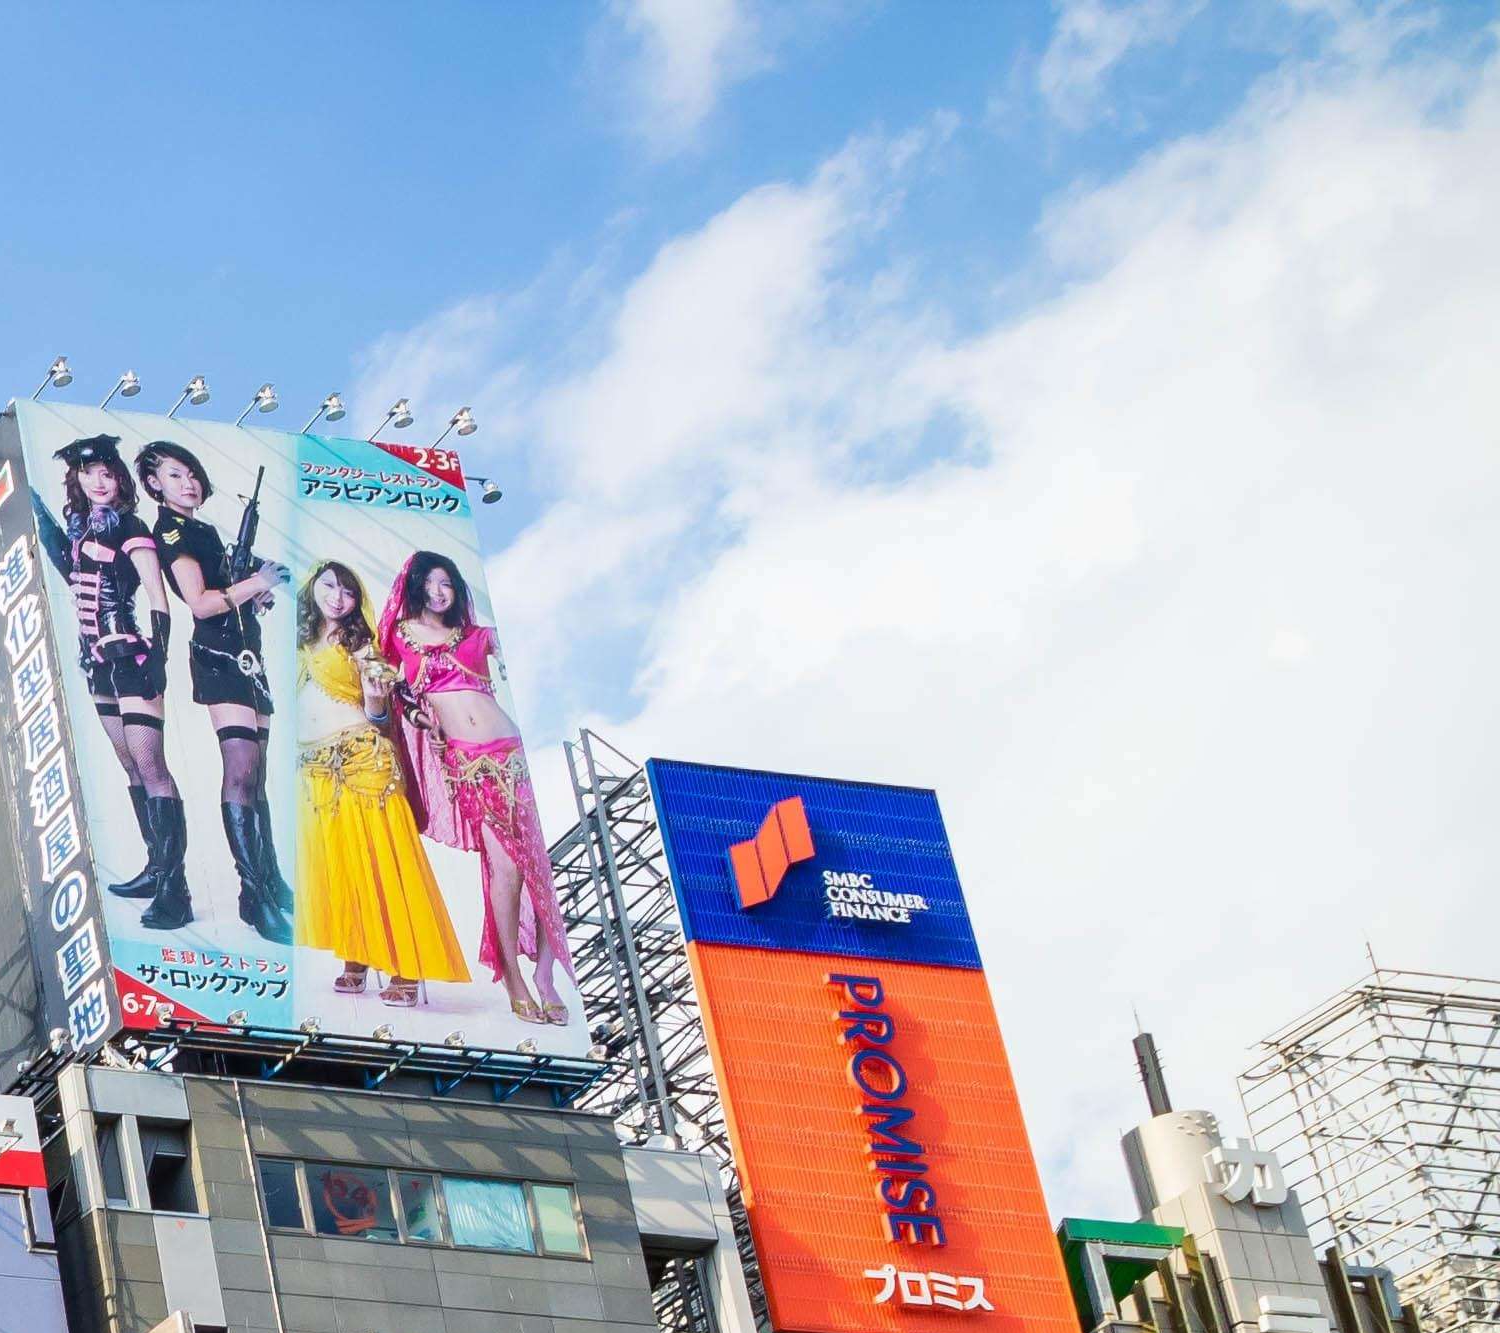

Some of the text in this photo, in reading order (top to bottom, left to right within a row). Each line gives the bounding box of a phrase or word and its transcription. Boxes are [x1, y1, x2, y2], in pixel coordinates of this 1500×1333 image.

[300, 479, 461, 514] アラビアンロック
[823, 869, 874, 890] SMBC
[826, 886, 929, 911] CONSUMER
[830, 901, 912, 925] FINANCE
[160, 947, 289, 975] 監獄レストラン
[135, 966, 290, 1001] ザ・ロックアップ
[824, 972, 948, 1249] PROMISE
[863, 1263, 996, 1313] プロミス
